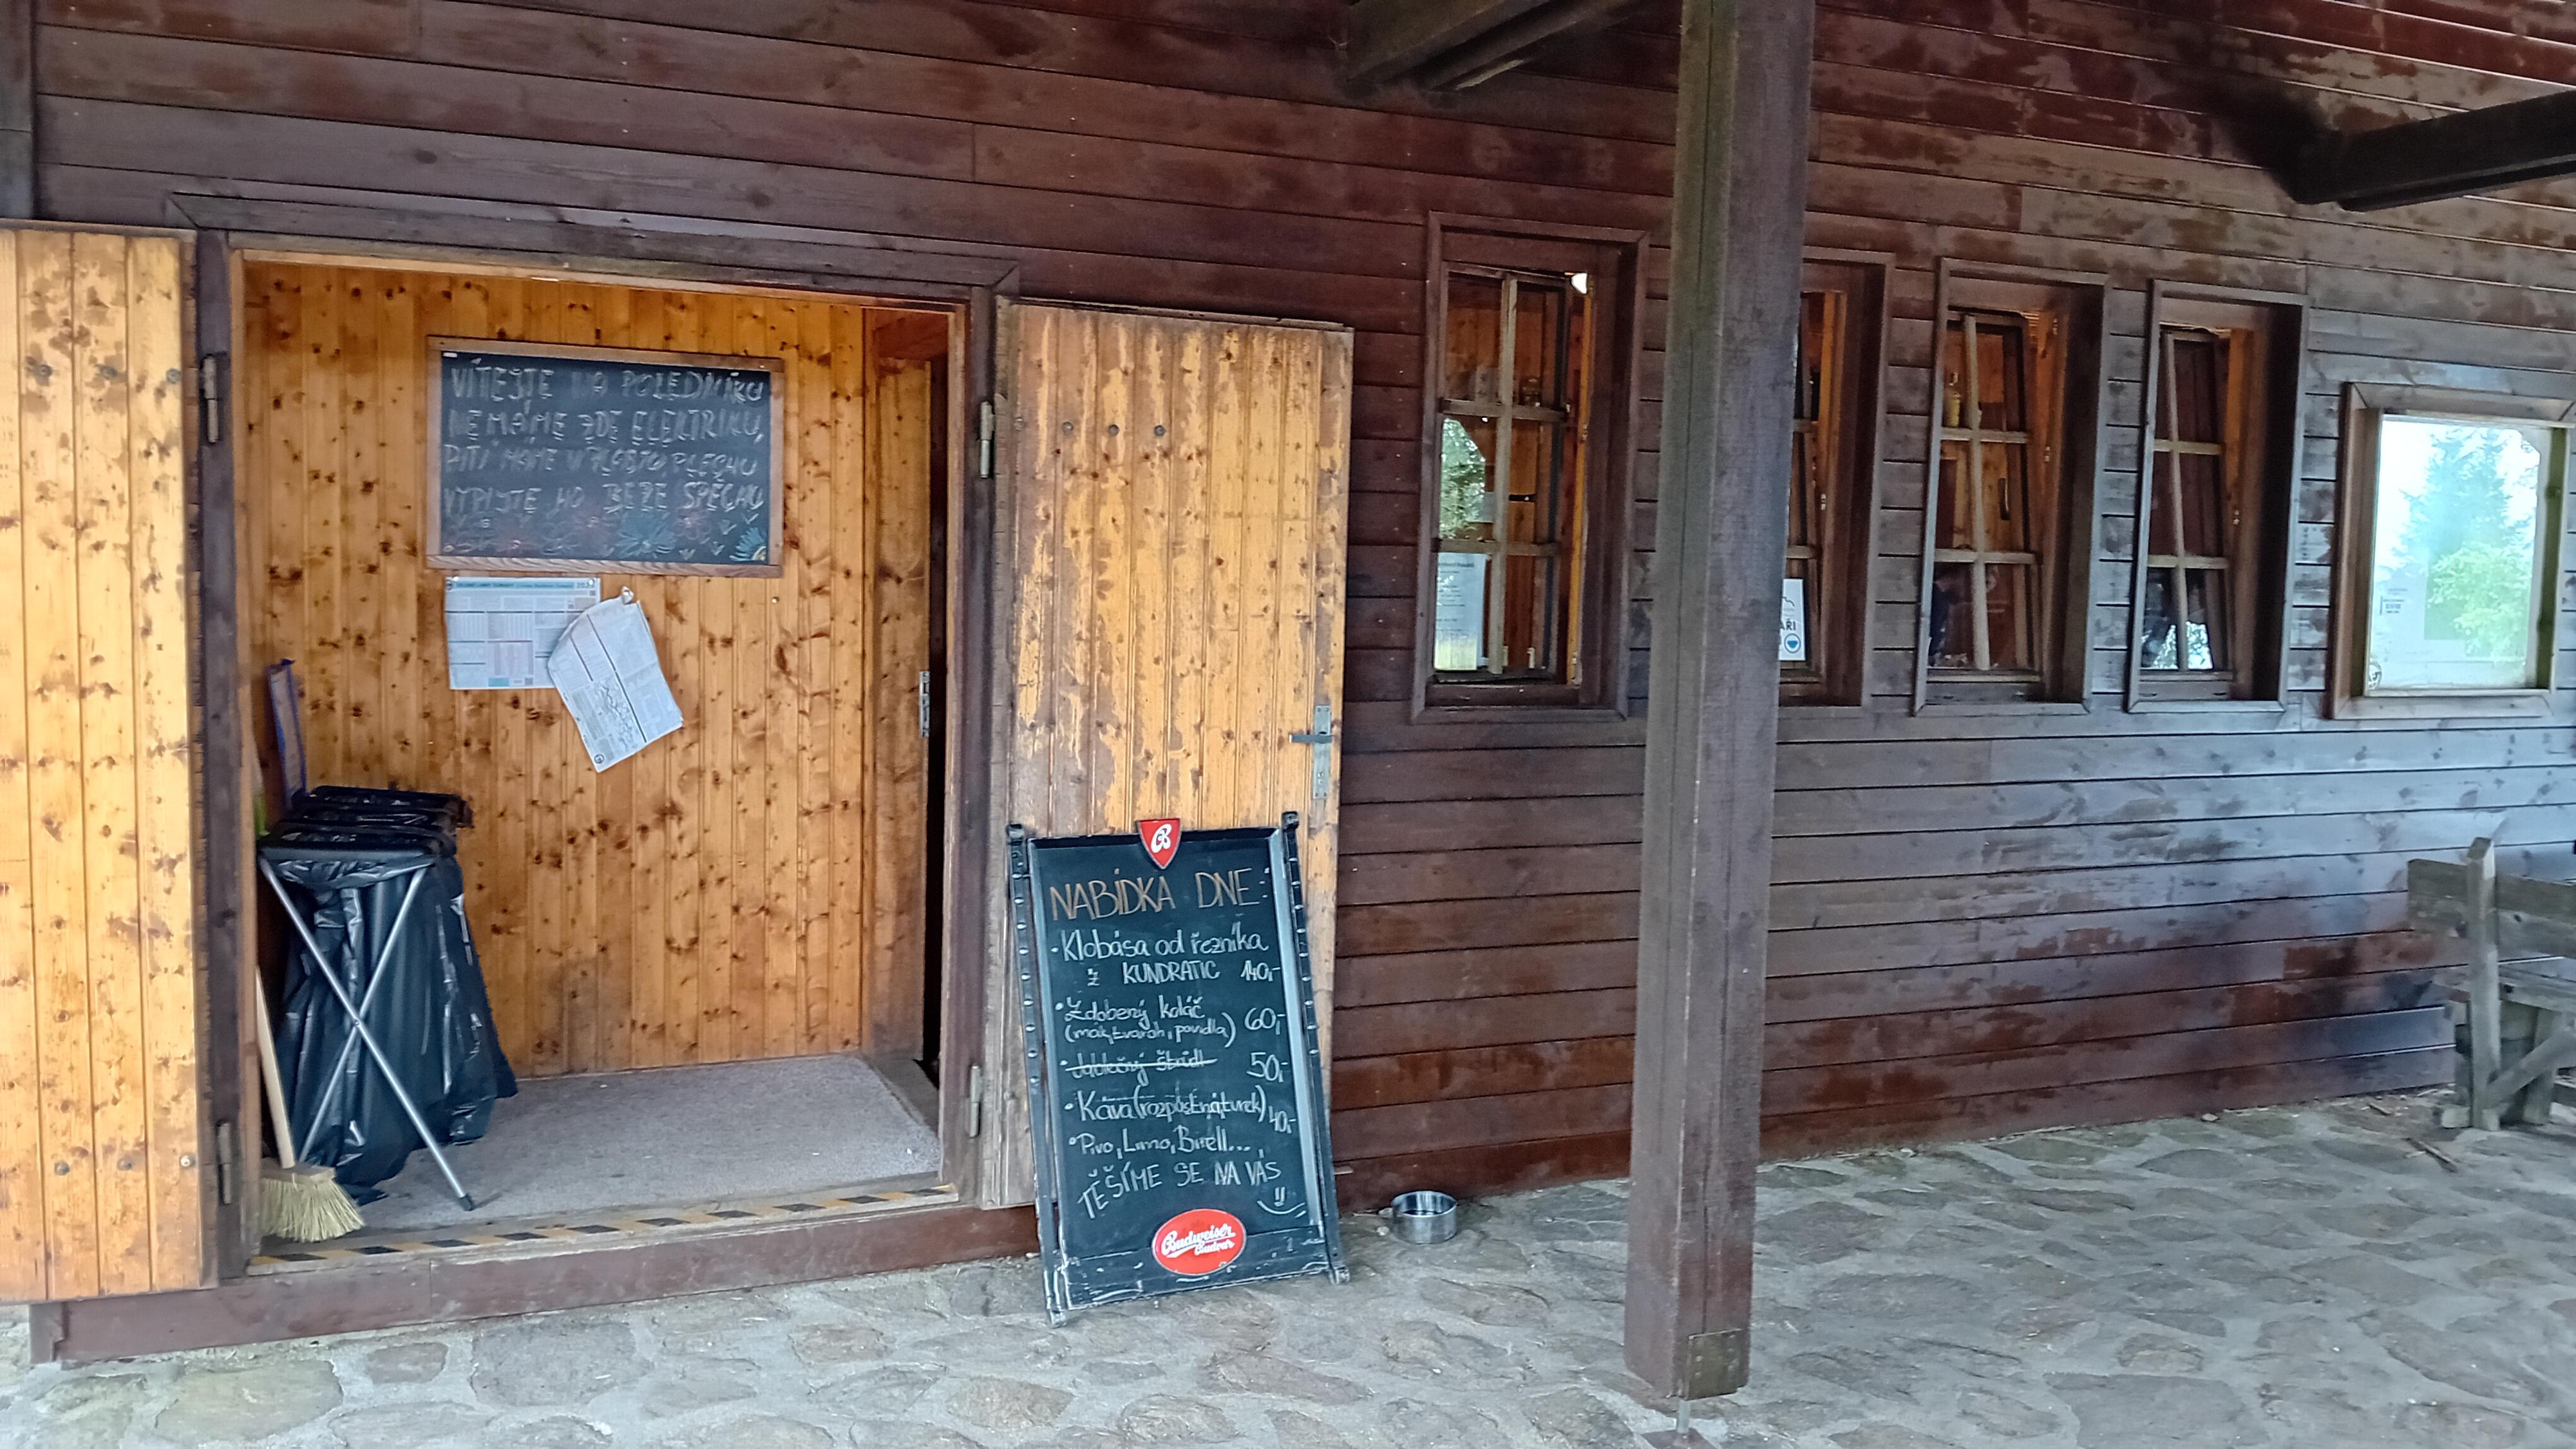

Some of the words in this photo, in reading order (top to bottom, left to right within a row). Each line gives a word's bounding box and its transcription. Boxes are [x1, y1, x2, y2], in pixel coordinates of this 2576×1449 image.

[572, 370, 609, 397] NA
[578, 410, 623, 444] ZDE
[1050, 868, 1176, 921] NABÍDKA
[1061, 929, 1151, 961] Klobása
[1155, 929, 1185, 956] od
[1191, 922, 1269, 954] řezníka
[1122, 960, 1221, 985] KUNDRATIC
[1159, 994, 1206, 1019] koláč
[1077, 1161, 1162, 1219] TĚŠÍME
[1173, 1162, 1205, 1186] SE
[1214, 1161, 1242, 1186] NA
[1244, 1148, 1282, 1186] VÁS
[1161, 1224, 1236, 1258] Budweiser
